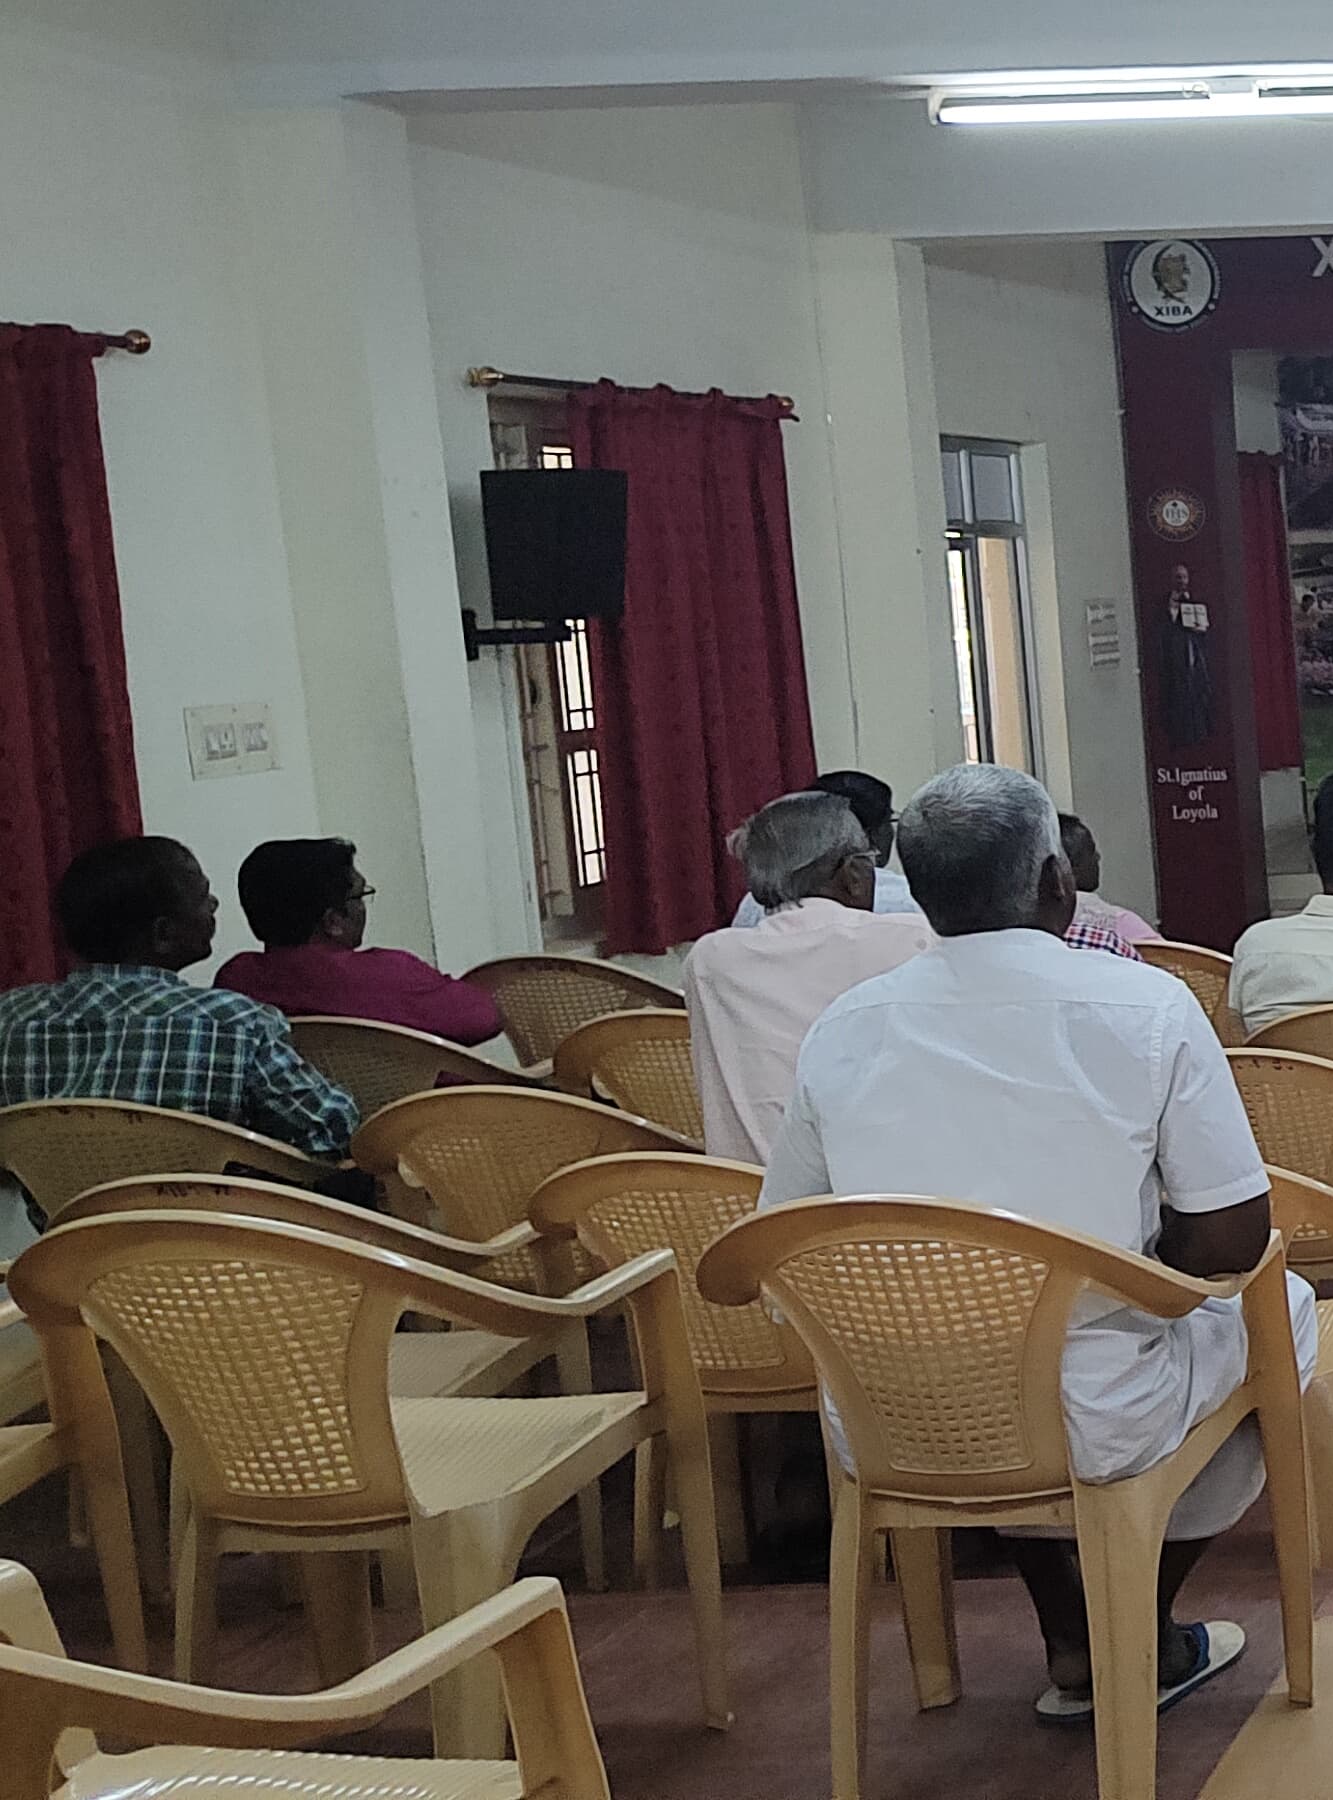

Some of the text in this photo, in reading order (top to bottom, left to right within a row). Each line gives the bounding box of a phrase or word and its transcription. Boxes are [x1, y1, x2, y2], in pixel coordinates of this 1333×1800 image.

[1154, 305, 1193, 316] XIBA
[1189, 785, 1204, 801] of
[1172, 803, 1219, 824] Loyola
